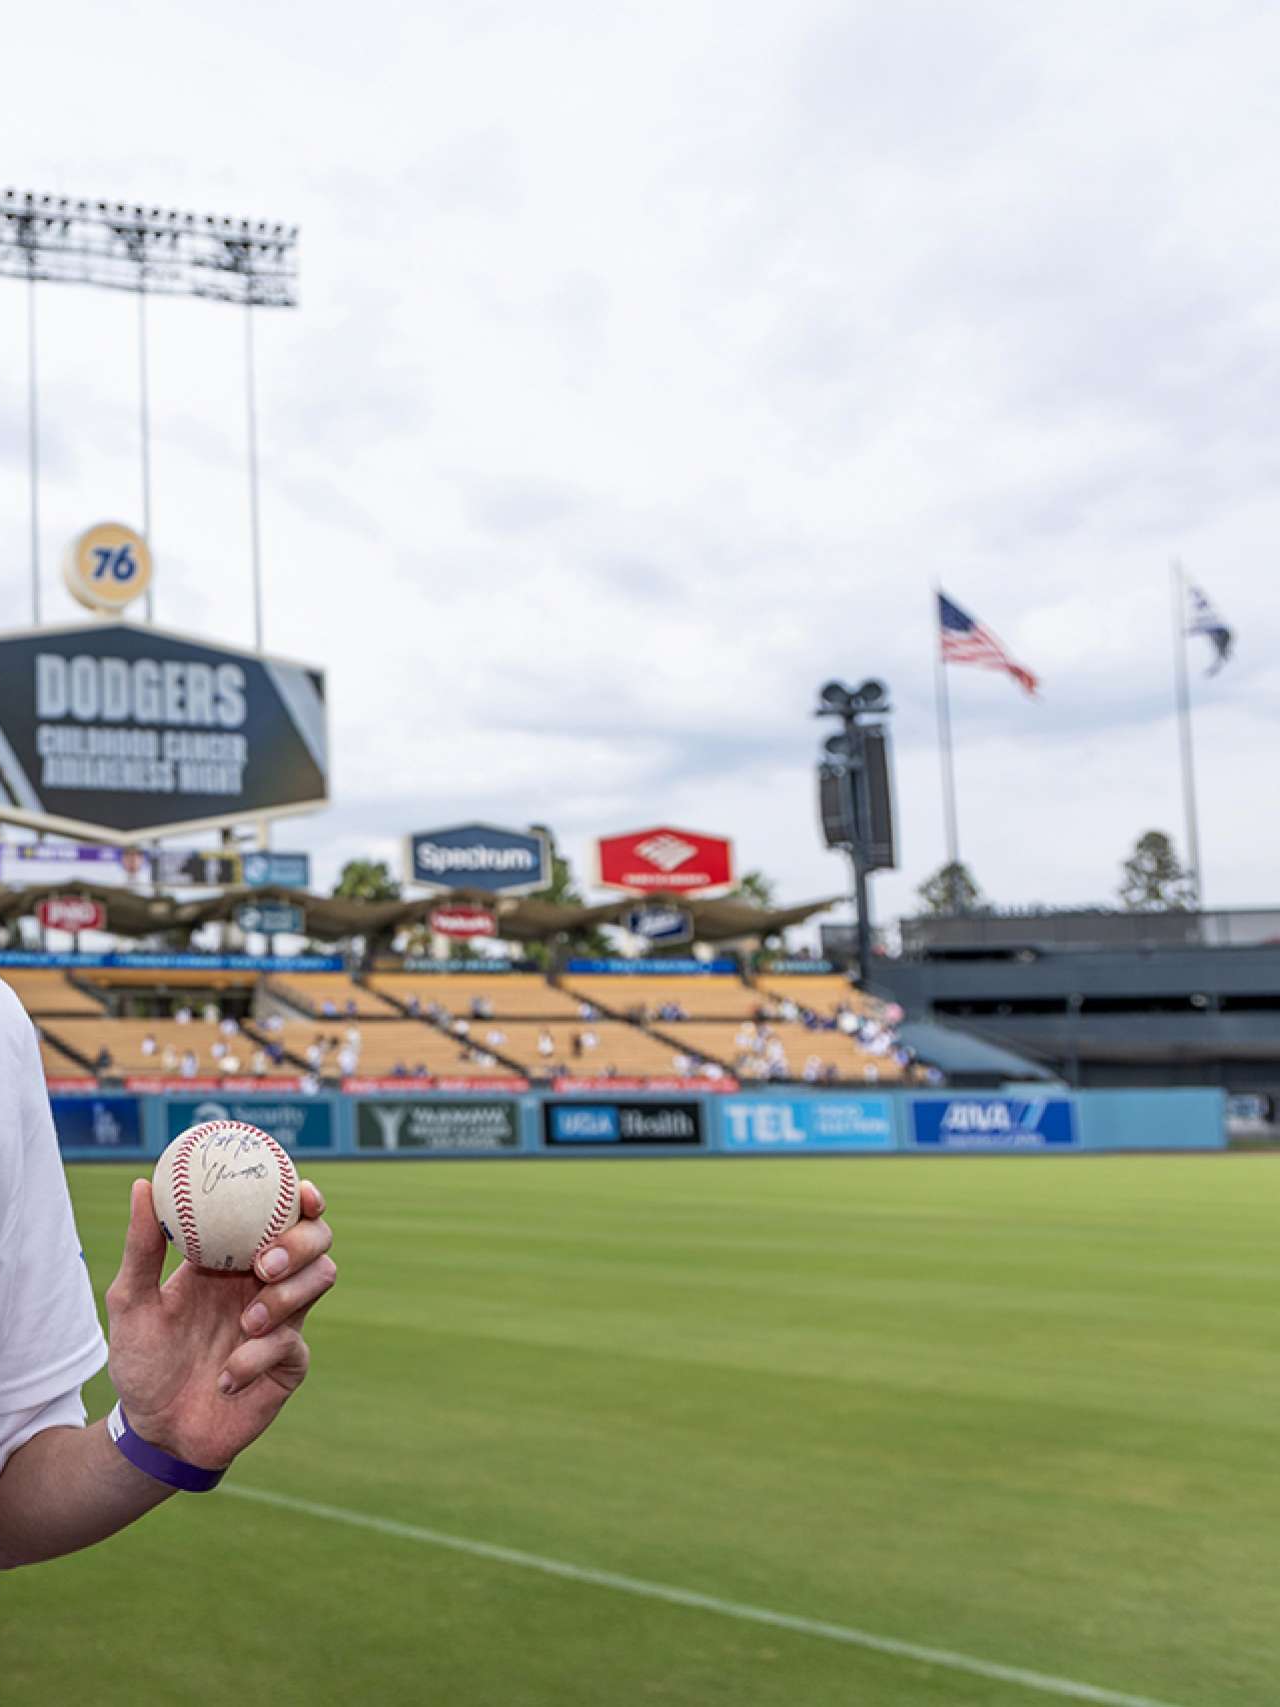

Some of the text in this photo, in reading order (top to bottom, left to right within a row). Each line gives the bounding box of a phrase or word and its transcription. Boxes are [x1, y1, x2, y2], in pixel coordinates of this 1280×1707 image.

[92, 544, 137, 583] 76
[35, 653, 247, 728] DODGERS
[418, 842, 533, 873] Spectrum
[622, 1107, 695, 1138] Health
[724, 1103, 807, 1142] TEL
